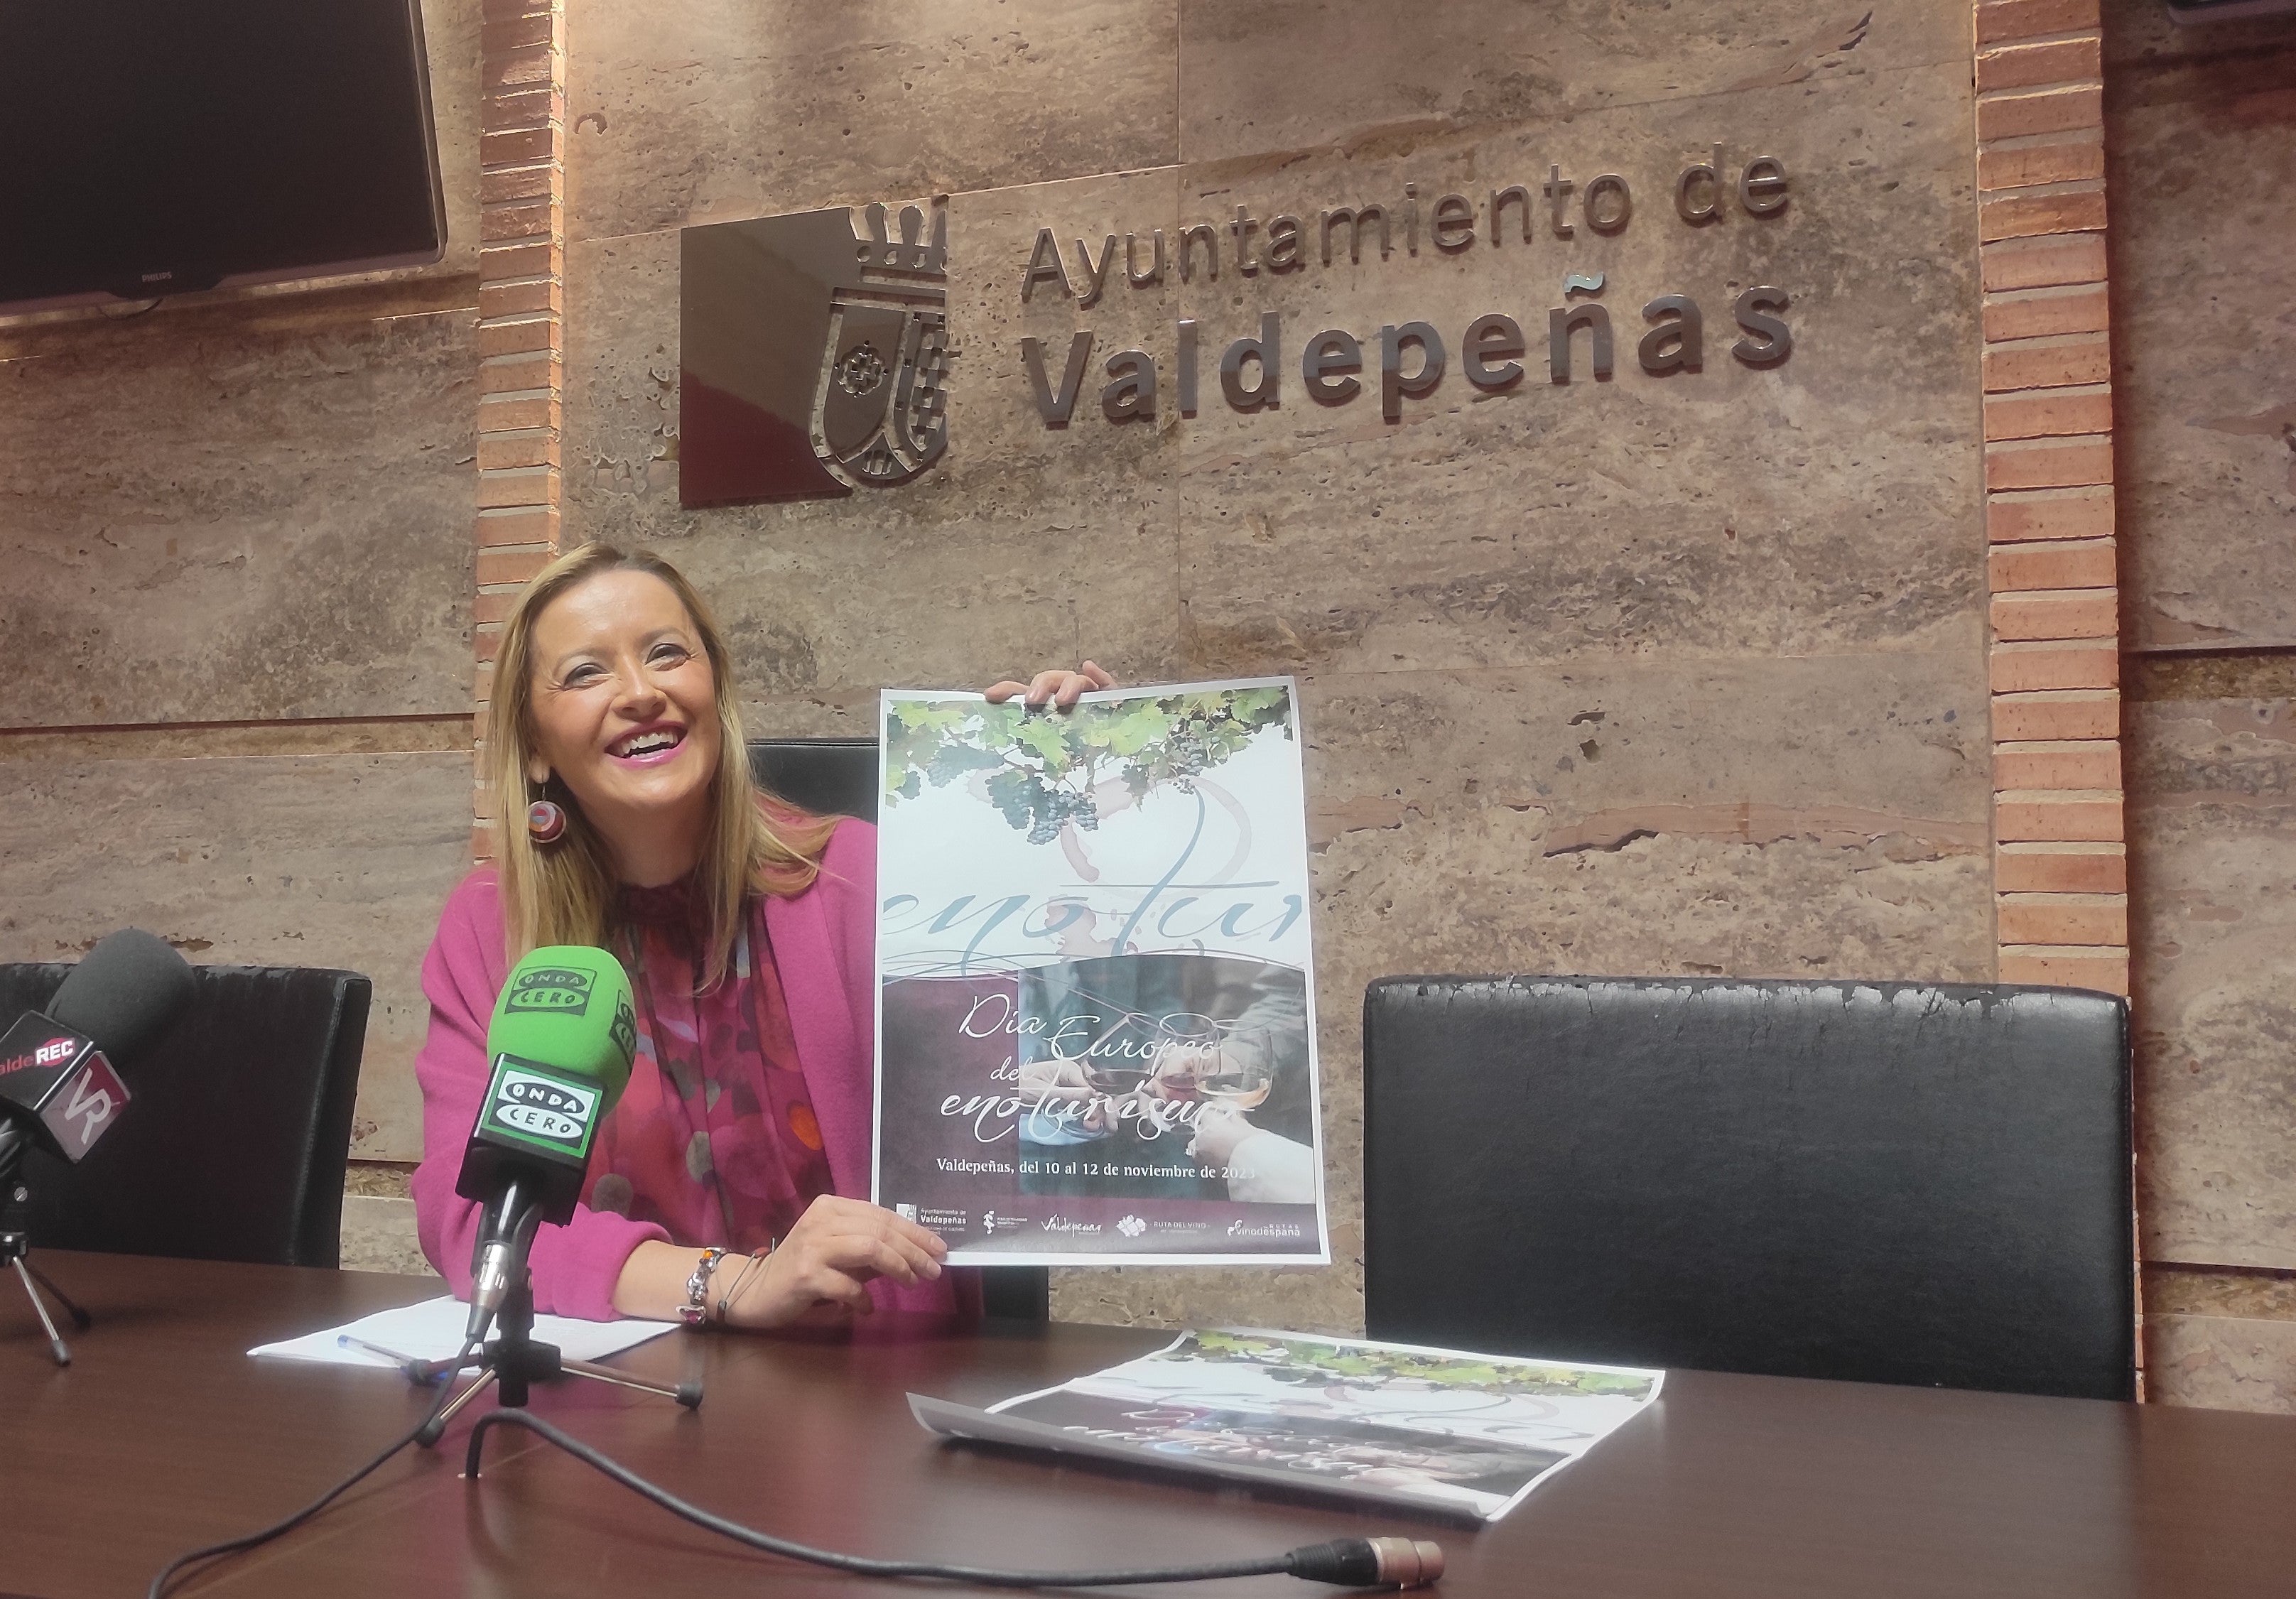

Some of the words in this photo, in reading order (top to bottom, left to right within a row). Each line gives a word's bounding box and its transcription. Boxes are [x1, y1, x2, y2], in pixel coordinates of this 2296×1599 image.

[1021, 164, 1632, 304] Ayuntamiento
[1674, 141, 1787, 222] de
[142, 271, 172, 282] PHILIPS
[1021, 271, 1792, 425] Valdepeñas
[525, 974, 580, 985] ONDA
[521, 992, 575, 1004] CERO
[1042, 1015, 1223, 1075] Europeo
[990, 1056, 1035, 1081] del
[512, 1083, 577, 1112] ONDA
[509, 1108, 570, 1134] CERO
[936, 1158, 1014, 1175] Valdepeñas,
[1019, 1161, 1039, 1173] del
[1045, 1162, 1060, 1174] 10
[1064, 1162, 1076, 1175] al
[1083, 1163, 1099, 1176] 12
[1103, 1163, 1119, 1176] de
[1124, 1164, 1196, 1178] noviembre
[1200, 1165, 1216, 1178] de
